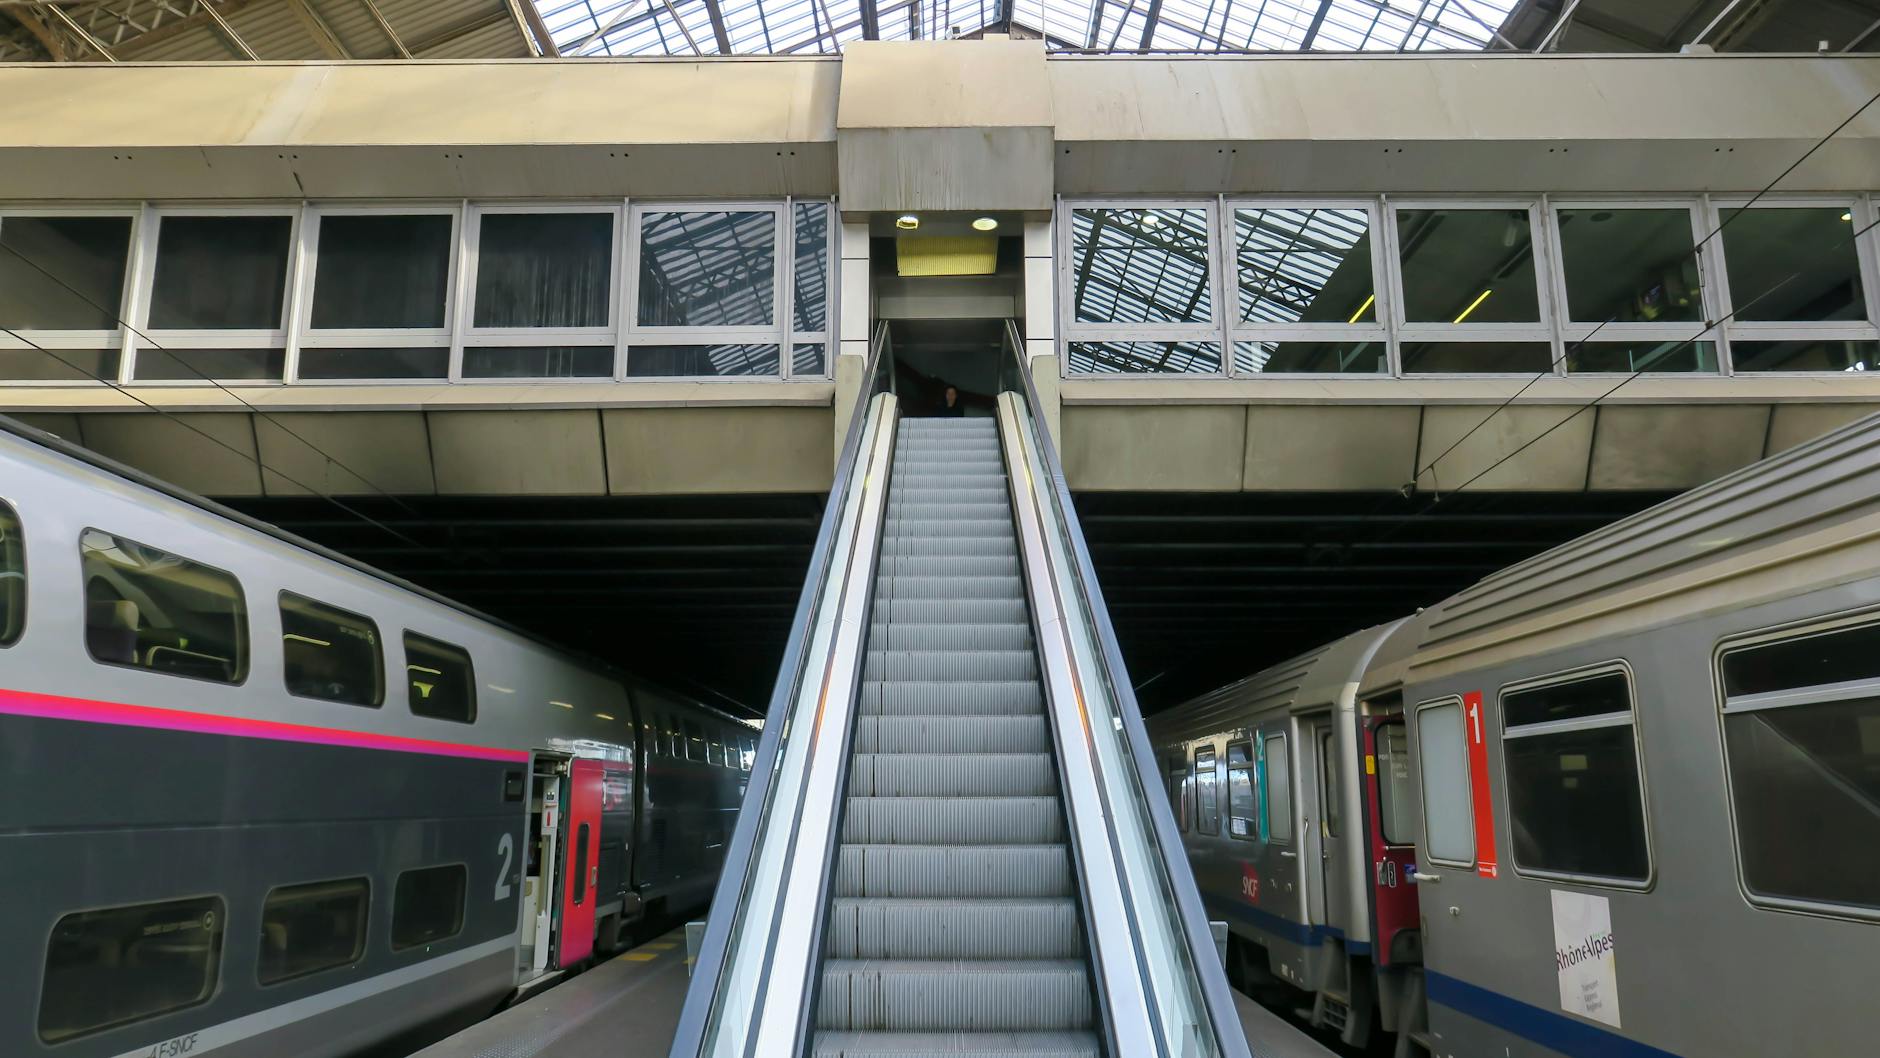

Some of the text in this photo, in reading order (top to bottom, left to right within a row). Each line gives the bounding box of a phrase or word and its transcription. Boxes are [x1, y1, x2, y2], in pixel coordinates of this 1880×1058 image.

[1469, 702, 1481, 744] 1
[1256, 740, 1264, 761] 2
[494, 832, 514, 901] 2
[1242, 873, 1258, 898] SNCF
